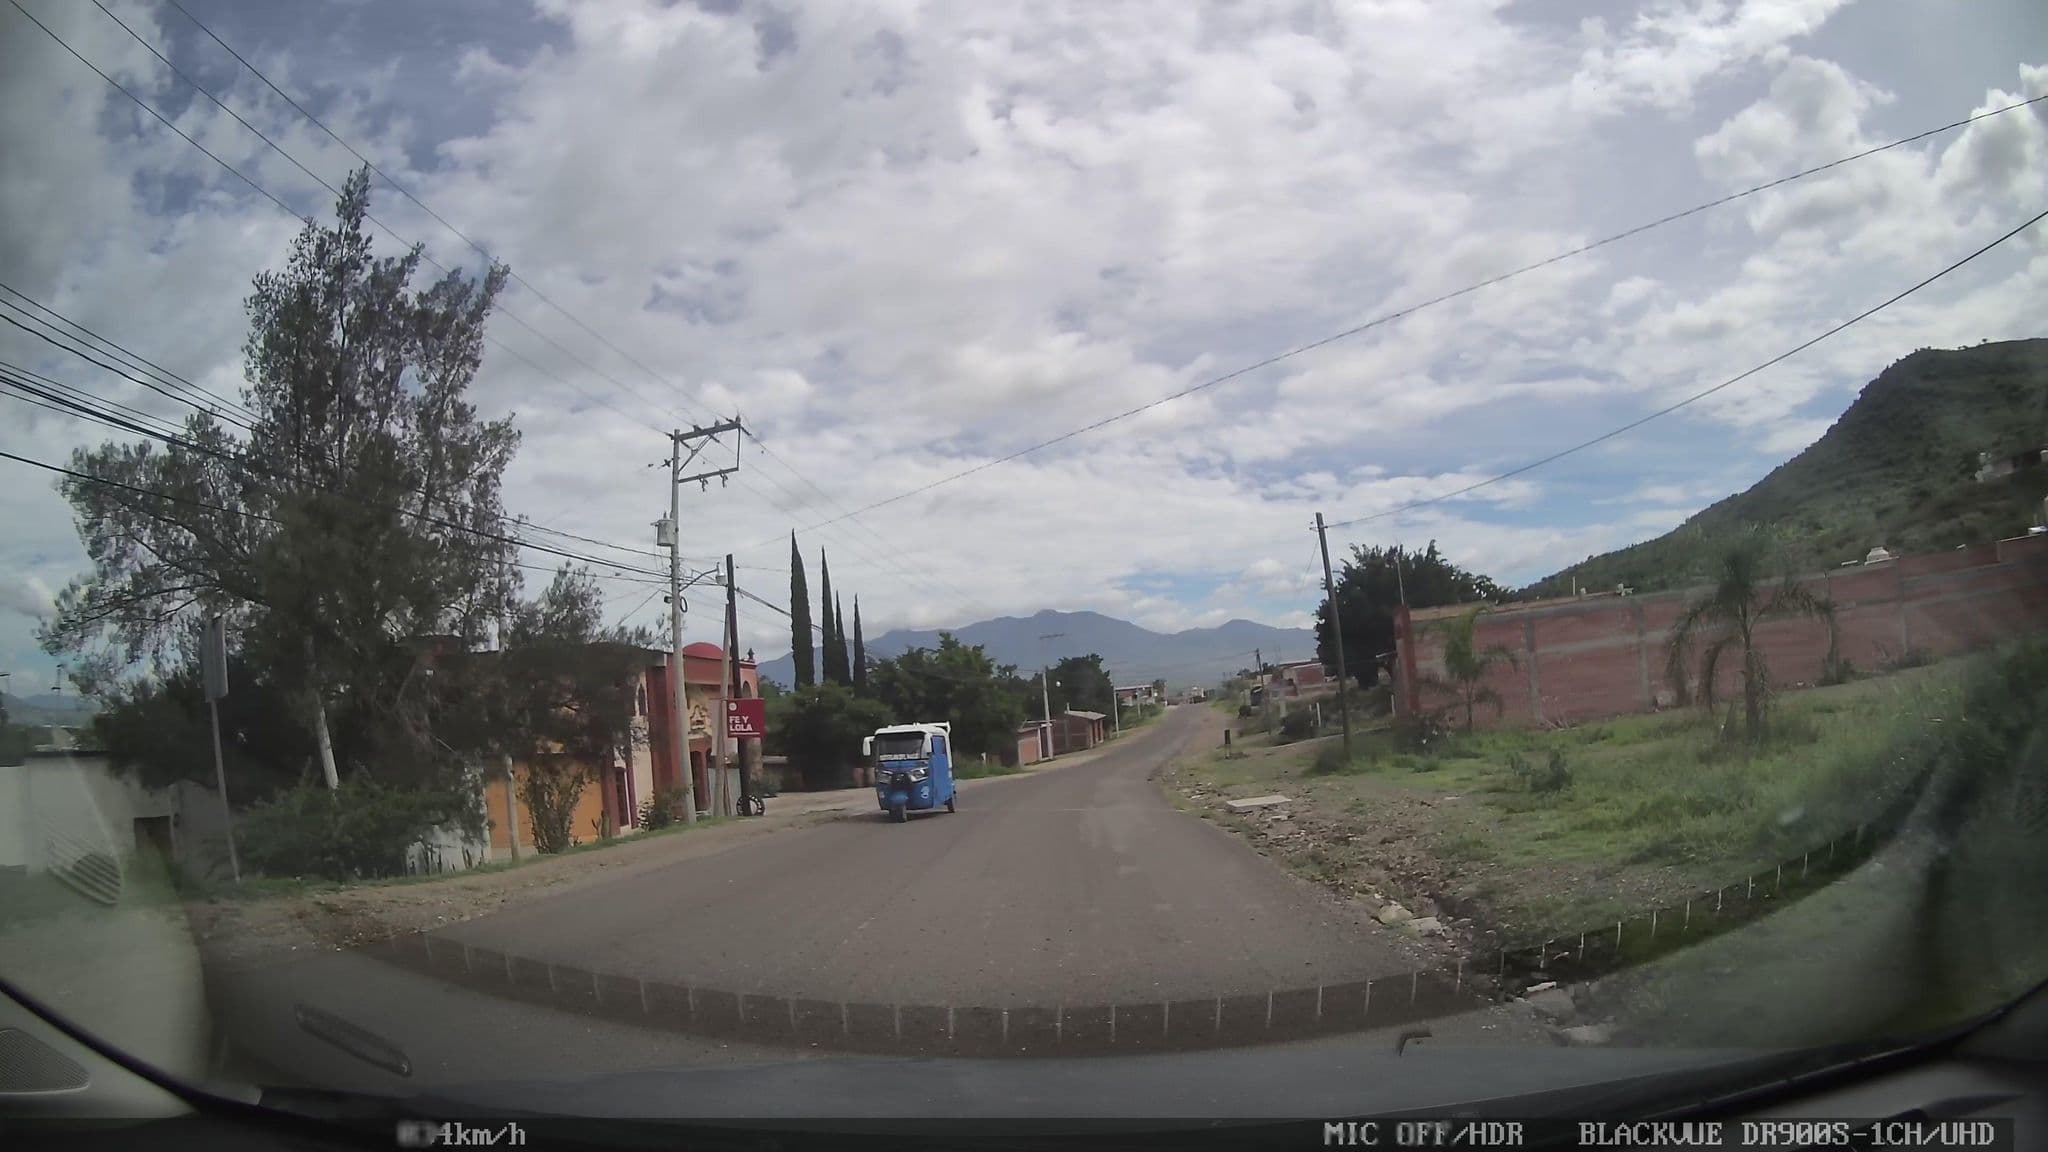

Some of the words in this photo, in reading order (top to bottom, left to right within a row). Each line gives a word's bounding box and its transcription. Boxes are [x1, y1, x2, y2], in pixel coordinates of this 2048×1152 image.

[729, 715, 740, 724] FE
[742, 715, 749, 724] Y
[729, 723, 753, 732] LOLA
